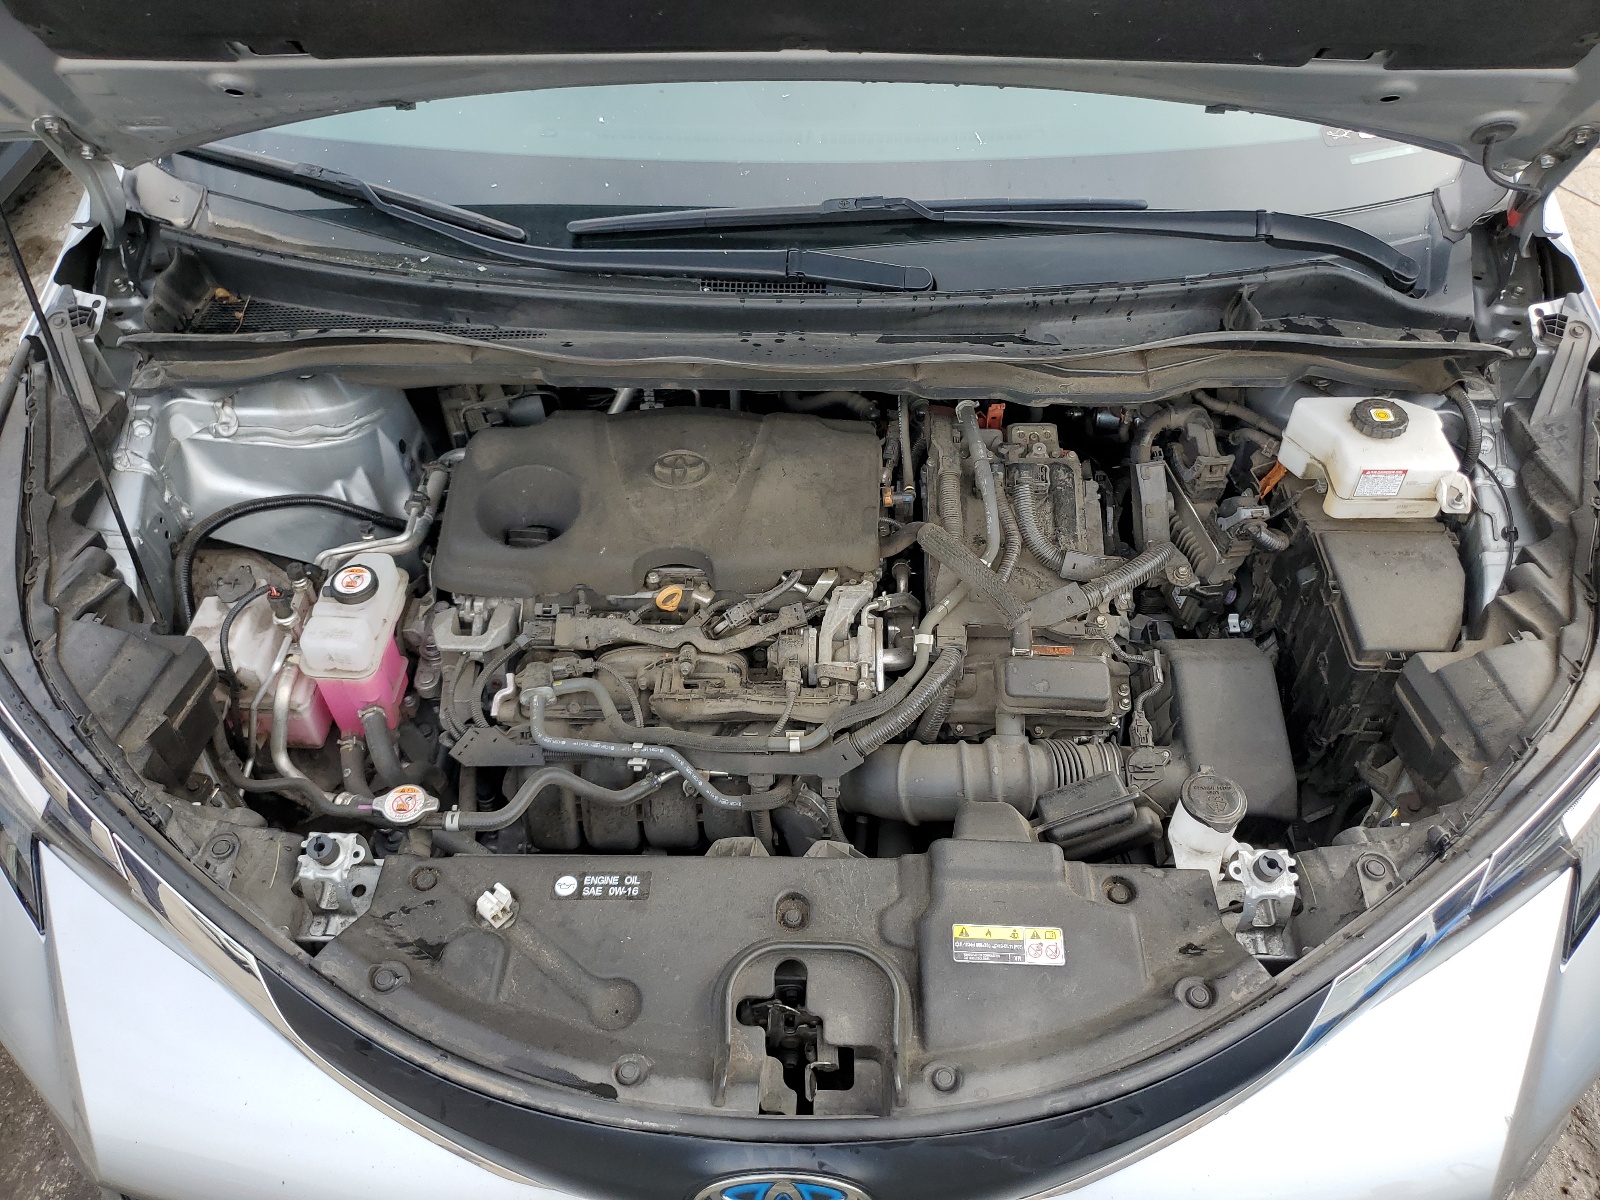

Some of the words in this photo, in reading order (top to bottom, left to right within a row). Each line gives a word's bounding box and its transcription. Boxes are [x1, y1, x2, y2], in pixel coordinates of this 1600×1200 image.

[583, 875, 619, 885] ENGINE
[624, 875, 641, 885] OIL
[582, 886, 603, 896] SAE
[608, 886, 639, 896] 0W-16
